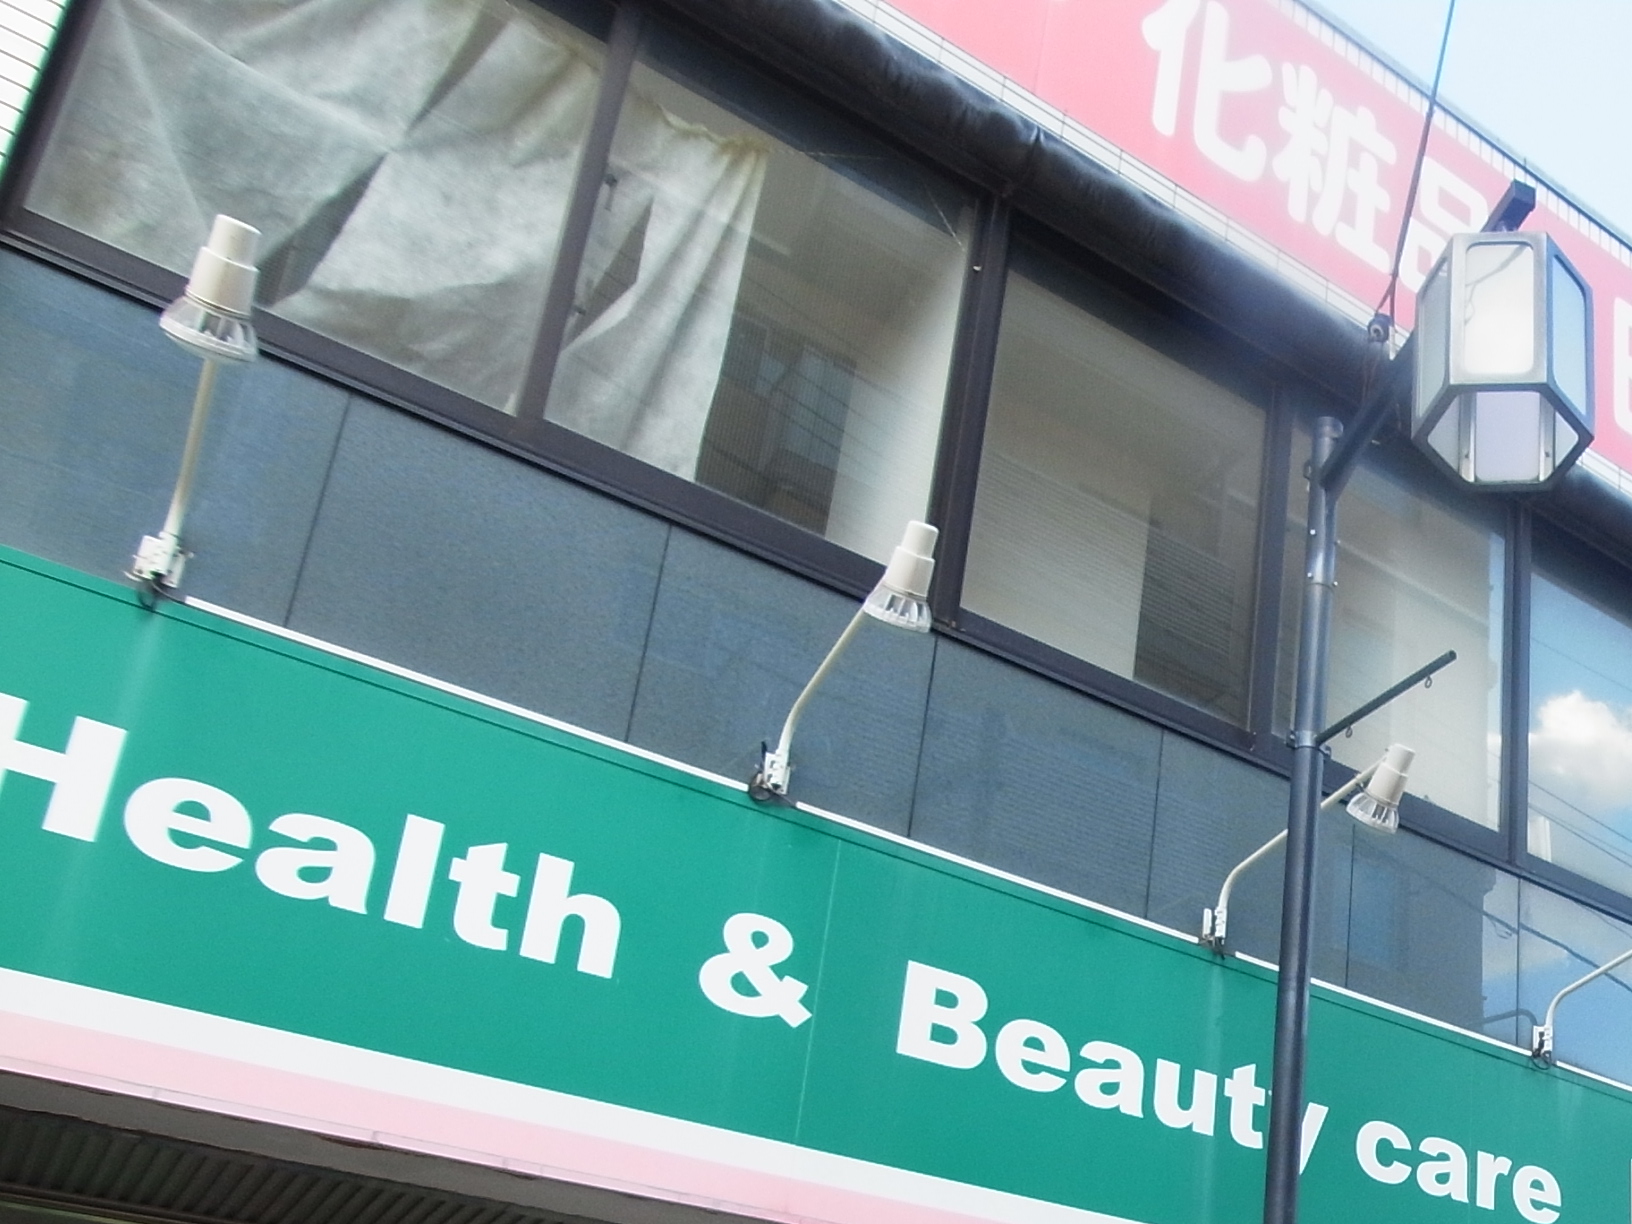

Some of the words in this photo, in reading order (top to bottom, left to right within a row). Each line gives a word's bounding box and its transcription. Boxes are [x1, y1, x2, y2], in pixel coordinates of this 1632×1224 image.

[0, 694, 622, 980] Health
[698, 912, 813, 1029] &
[1355, 1119, 1562, 1224] care
